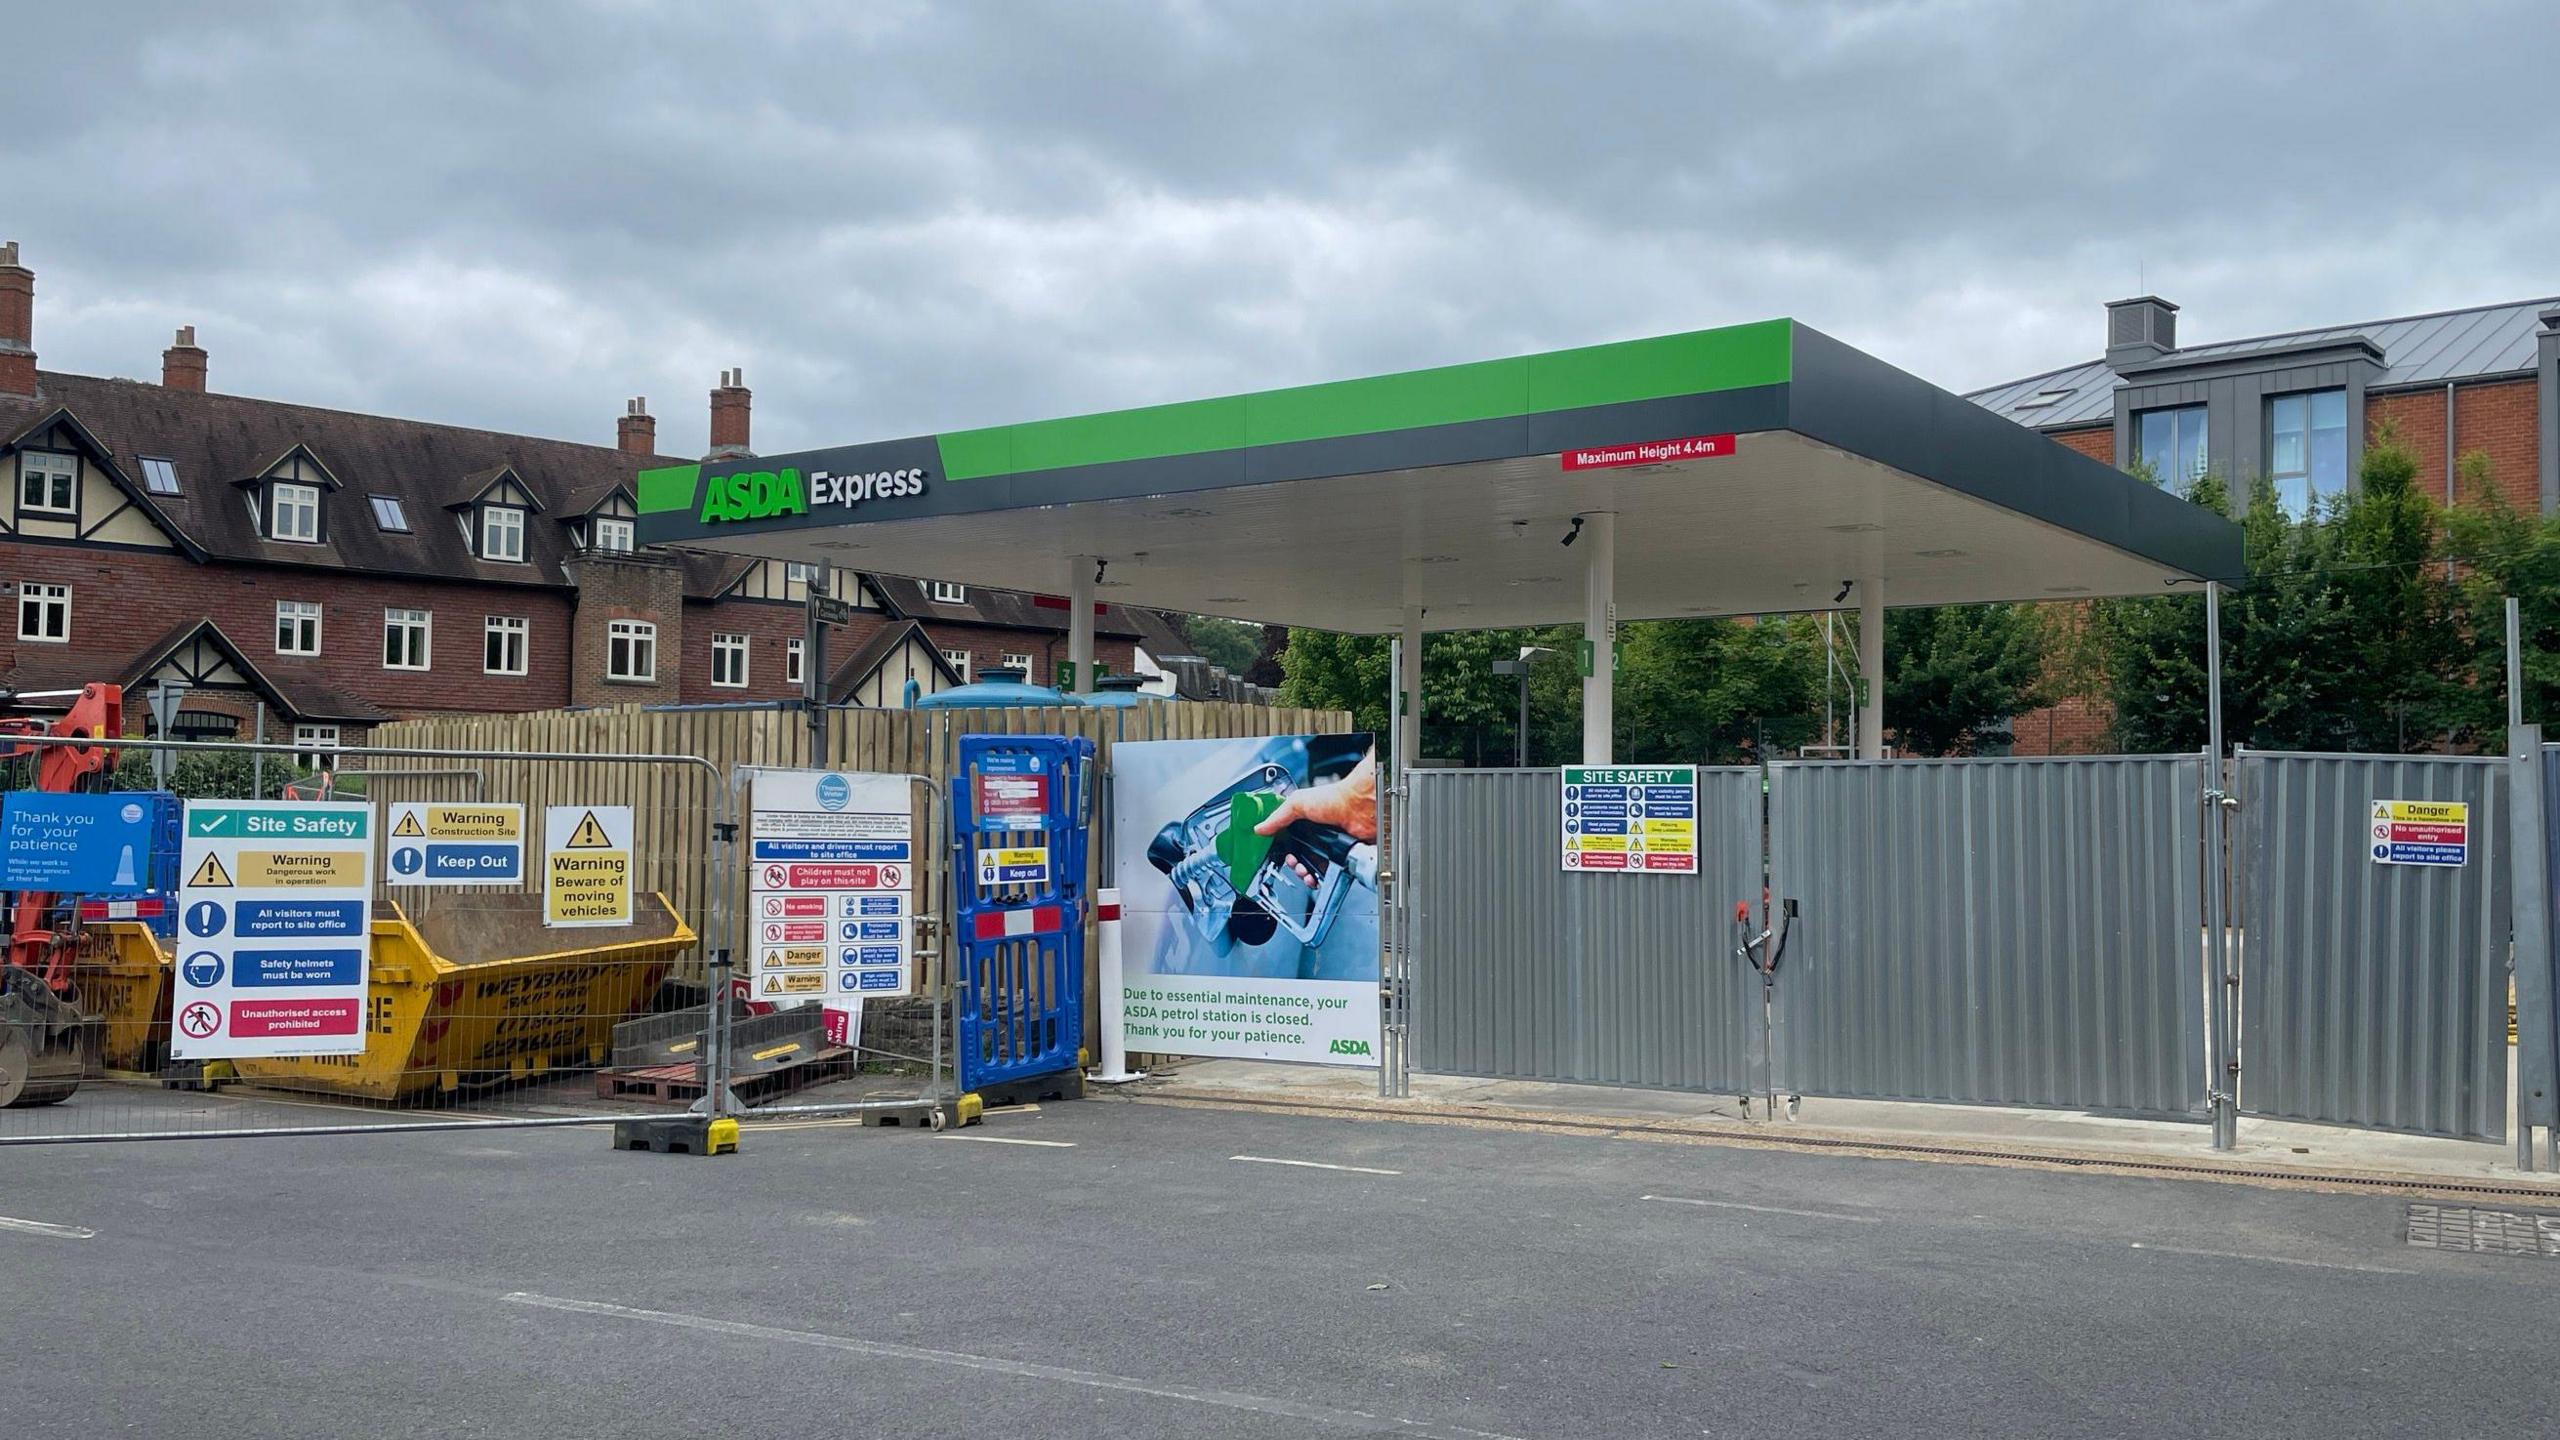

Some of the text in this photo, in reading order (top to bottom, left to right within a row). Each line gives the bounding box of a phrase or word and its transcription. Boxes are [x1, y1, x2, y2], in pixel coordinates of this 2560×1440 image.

[1577, 441, 1715, 465] Maximum Height 4.4m
[700, 468, 922, 523] ASDA Express
[1584, 650, 1588, 667] 1
[1062, 669, 1070, 683] 3
[1863, 686, 1868, 700] 5
[1583, 771, 1673, 783] SITE SAFETY
[2408, 805, 2449, 816] Danger
[13, 811, 94, 826] Thank you
[443, 812, 505, 827] Warning
[12, 824, 78, 839] for your
[247, 816, 357, 836] Site Safety
[430, 827, 516, 836] Construction Site
[2409, 826, 2462, 834] unauthorised
[2417, 834, 2438, 842] entry
[10, 839, 78, 851] patience
[875, 844, 897, 852] report
[2436, 846, 2460, 854] please
[272, 854, 331, 868] Warning
[2393, 853, 2415, 861] report
[437, 856, 507, 871] Keep Out
[554, 857, 625, 873] Warning
[266, 868, 337, 877] Dangerous work
[797, 868, 832, 876] Children
[1009, 869, 1037, 878] Keep out
[286, 878, 327, 886] operation
[555, 877, 624, 888] Beware of
[801, 878, 819, 886] play
[564, 892, 614, 903] moving
[258, 909, 340, 918] All visitors must
[561, 905, 617, 917] vehicles
[252, 920, 346, 931] report to site office
[787, 951, 821, 961] Danger
[260, 959, 334, 970] Safety helmets
[263, 971, 288, 980] must
[291, 970, 304, 979] be
[788, 975, 821, 984] Warning
[1124, 988, 1348, 1010] Due to essential maintenance, your
[242, 1008, 310, 1018] Unauthorised
[1124, 1006, 1312, 1026] ASDA petrol station is closed.
[268, 1019, 320, 1030] prohibited
[1124, 1023, 1305, 1044] Thank you for your patience.
[1329, 1039, 1371, 1056] ASDA
